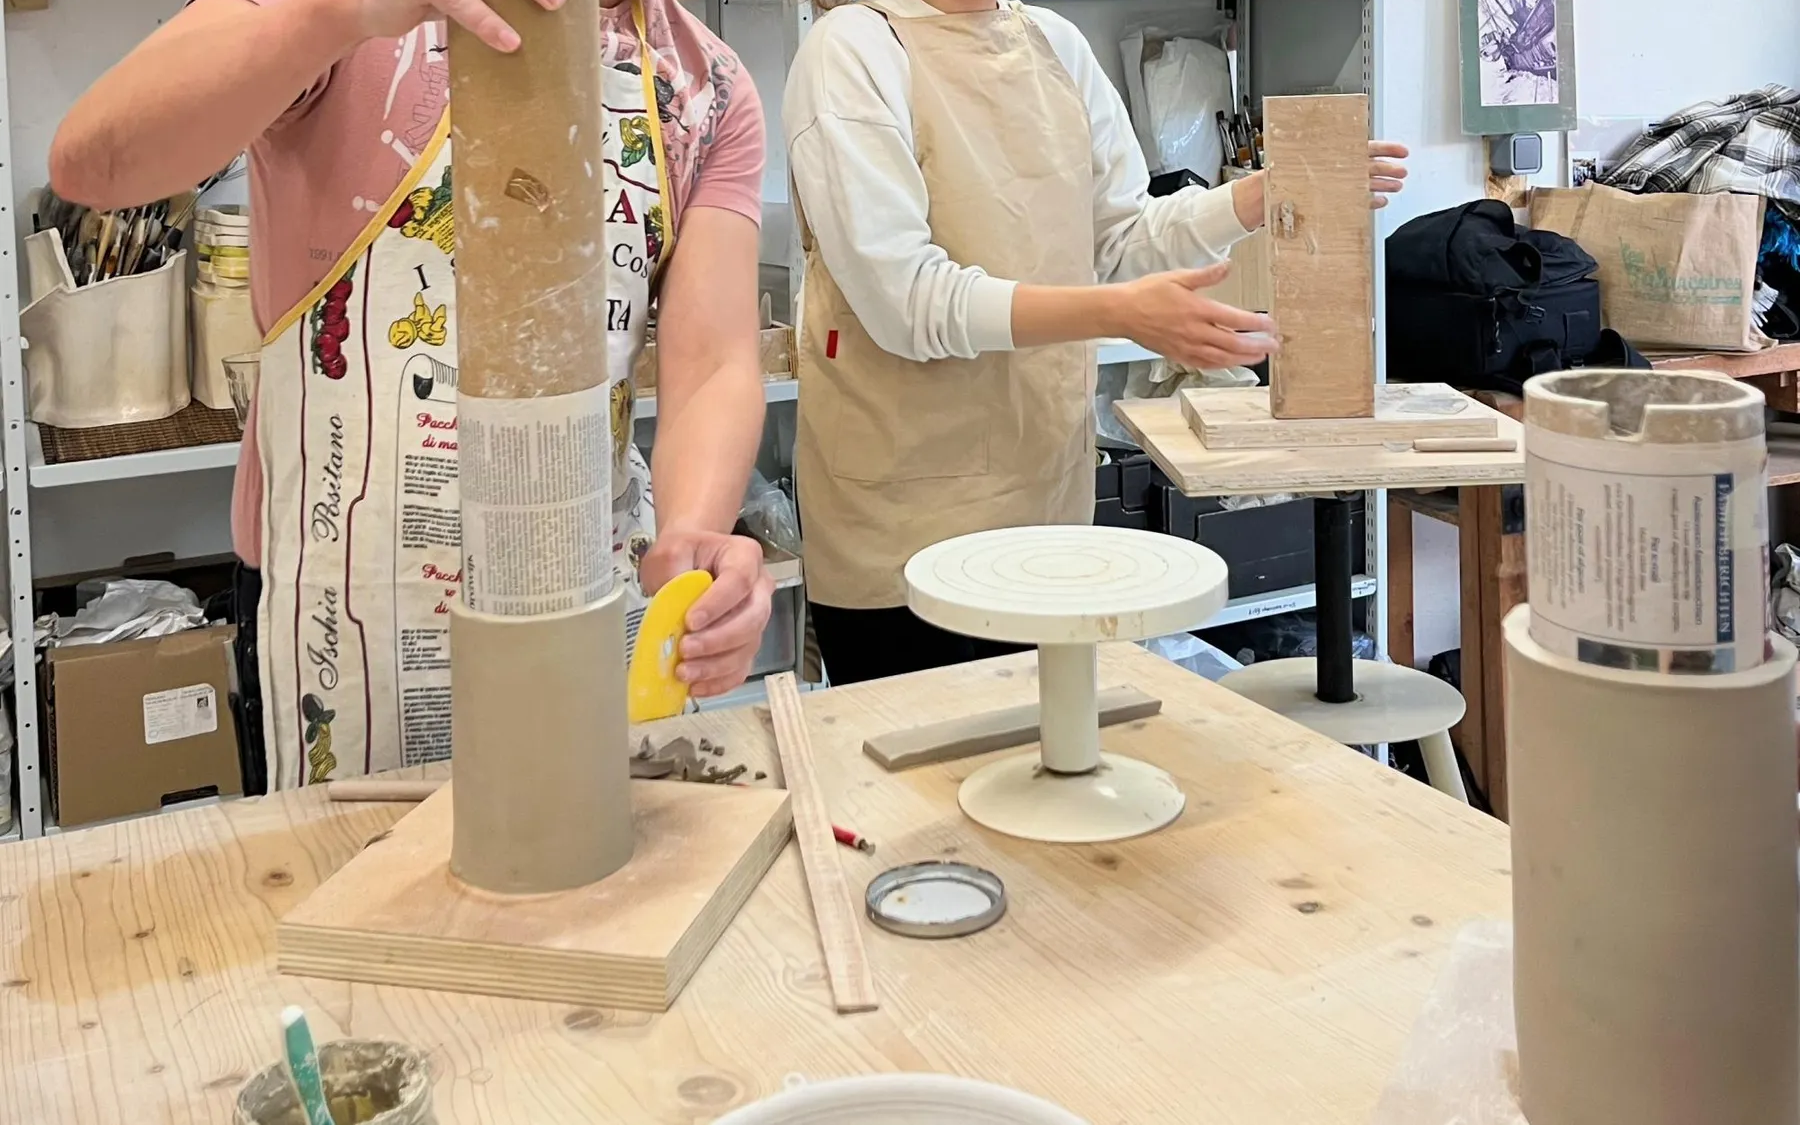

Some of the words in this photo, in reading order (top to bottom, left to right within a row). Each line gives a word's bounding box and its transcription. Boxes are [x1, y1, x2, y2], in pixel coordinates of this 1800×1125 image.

[422, 434, 437, 448] di
[311, 413, 344, 543] Positano
[434, 600, 449, 614] di
[307, 586, 339, 690] Ischia
